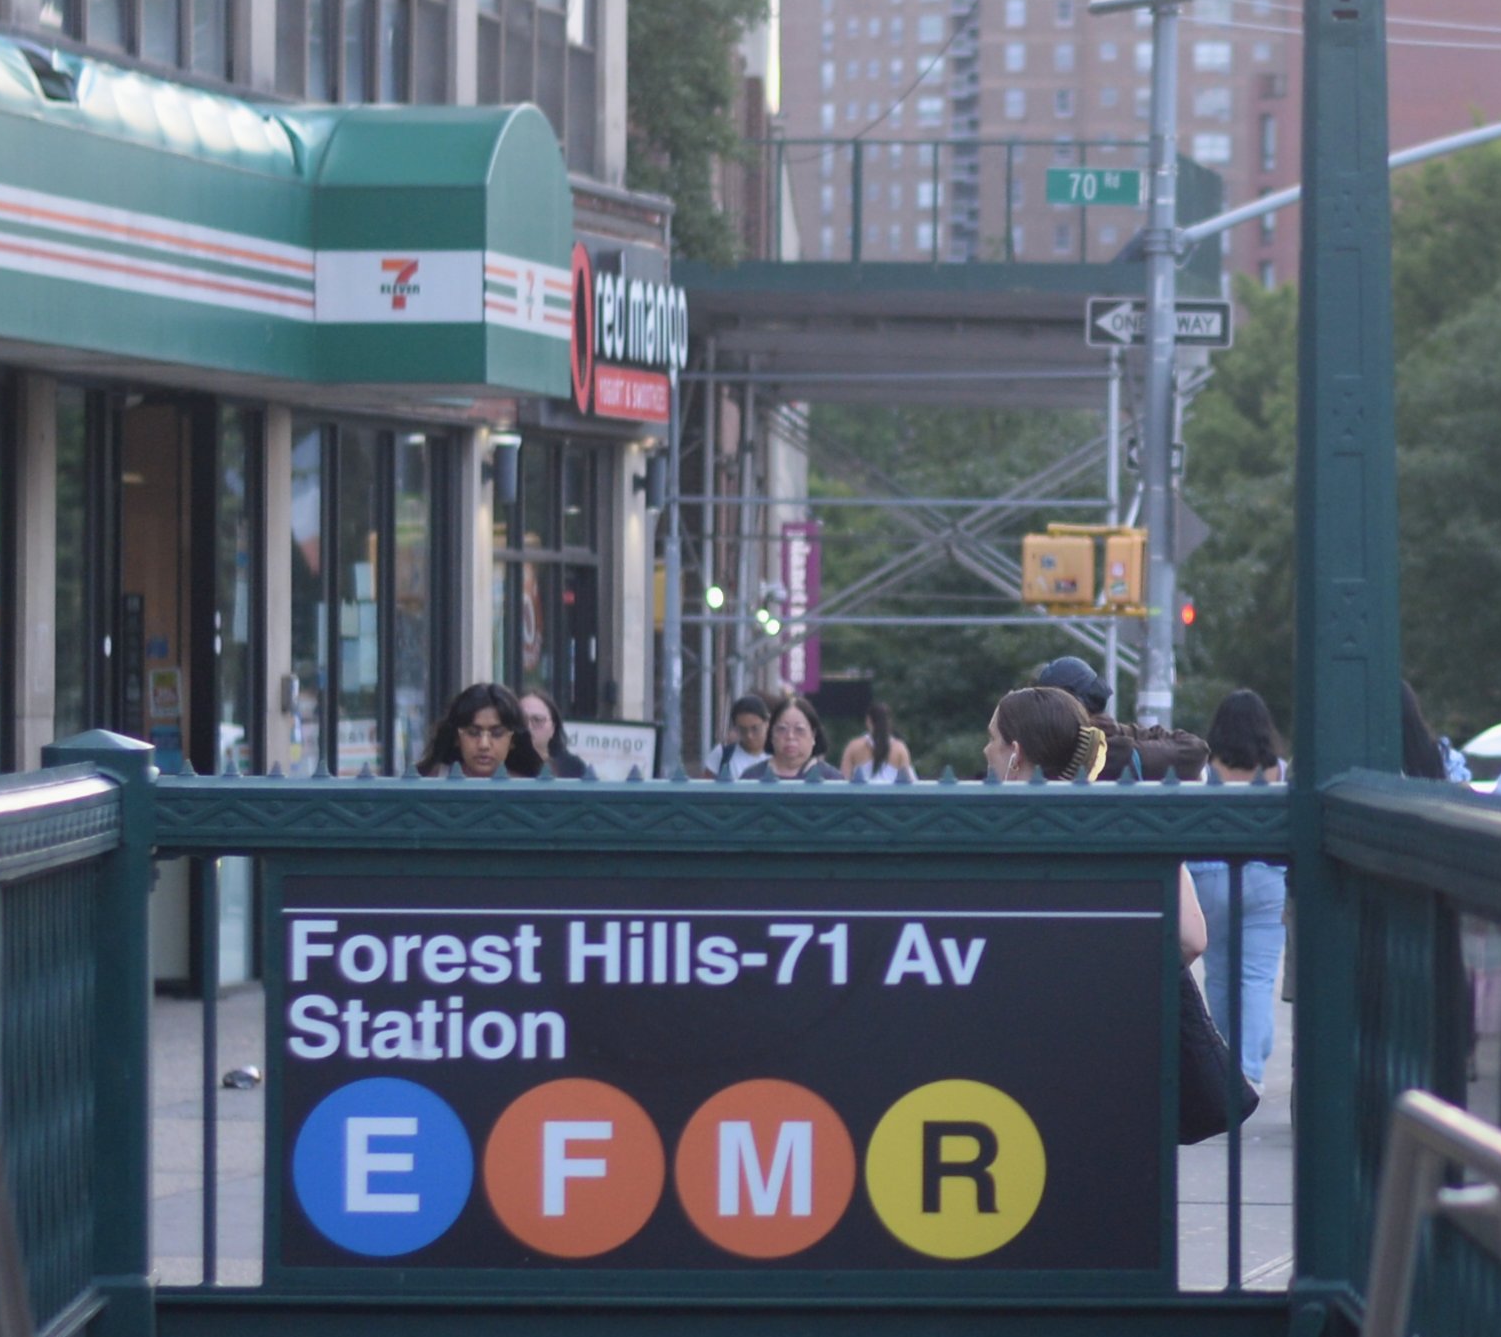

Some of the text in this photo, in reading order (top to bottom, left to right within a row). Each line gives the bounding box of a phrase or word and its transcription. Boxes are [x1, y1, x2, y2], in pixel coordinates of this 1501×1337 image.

[1069, 172, 1120, 200] 70 Rd
[594, 250, 689, 391] red mango
[1177, 315, 1214, 334] WAY
[586, 735, 643, 756] mango
[288, 920, 987, 985] Forest Hills-71 Av
[288, 995, 567, 1060] Station
[344, 1117, 999, 1217] E F M R
